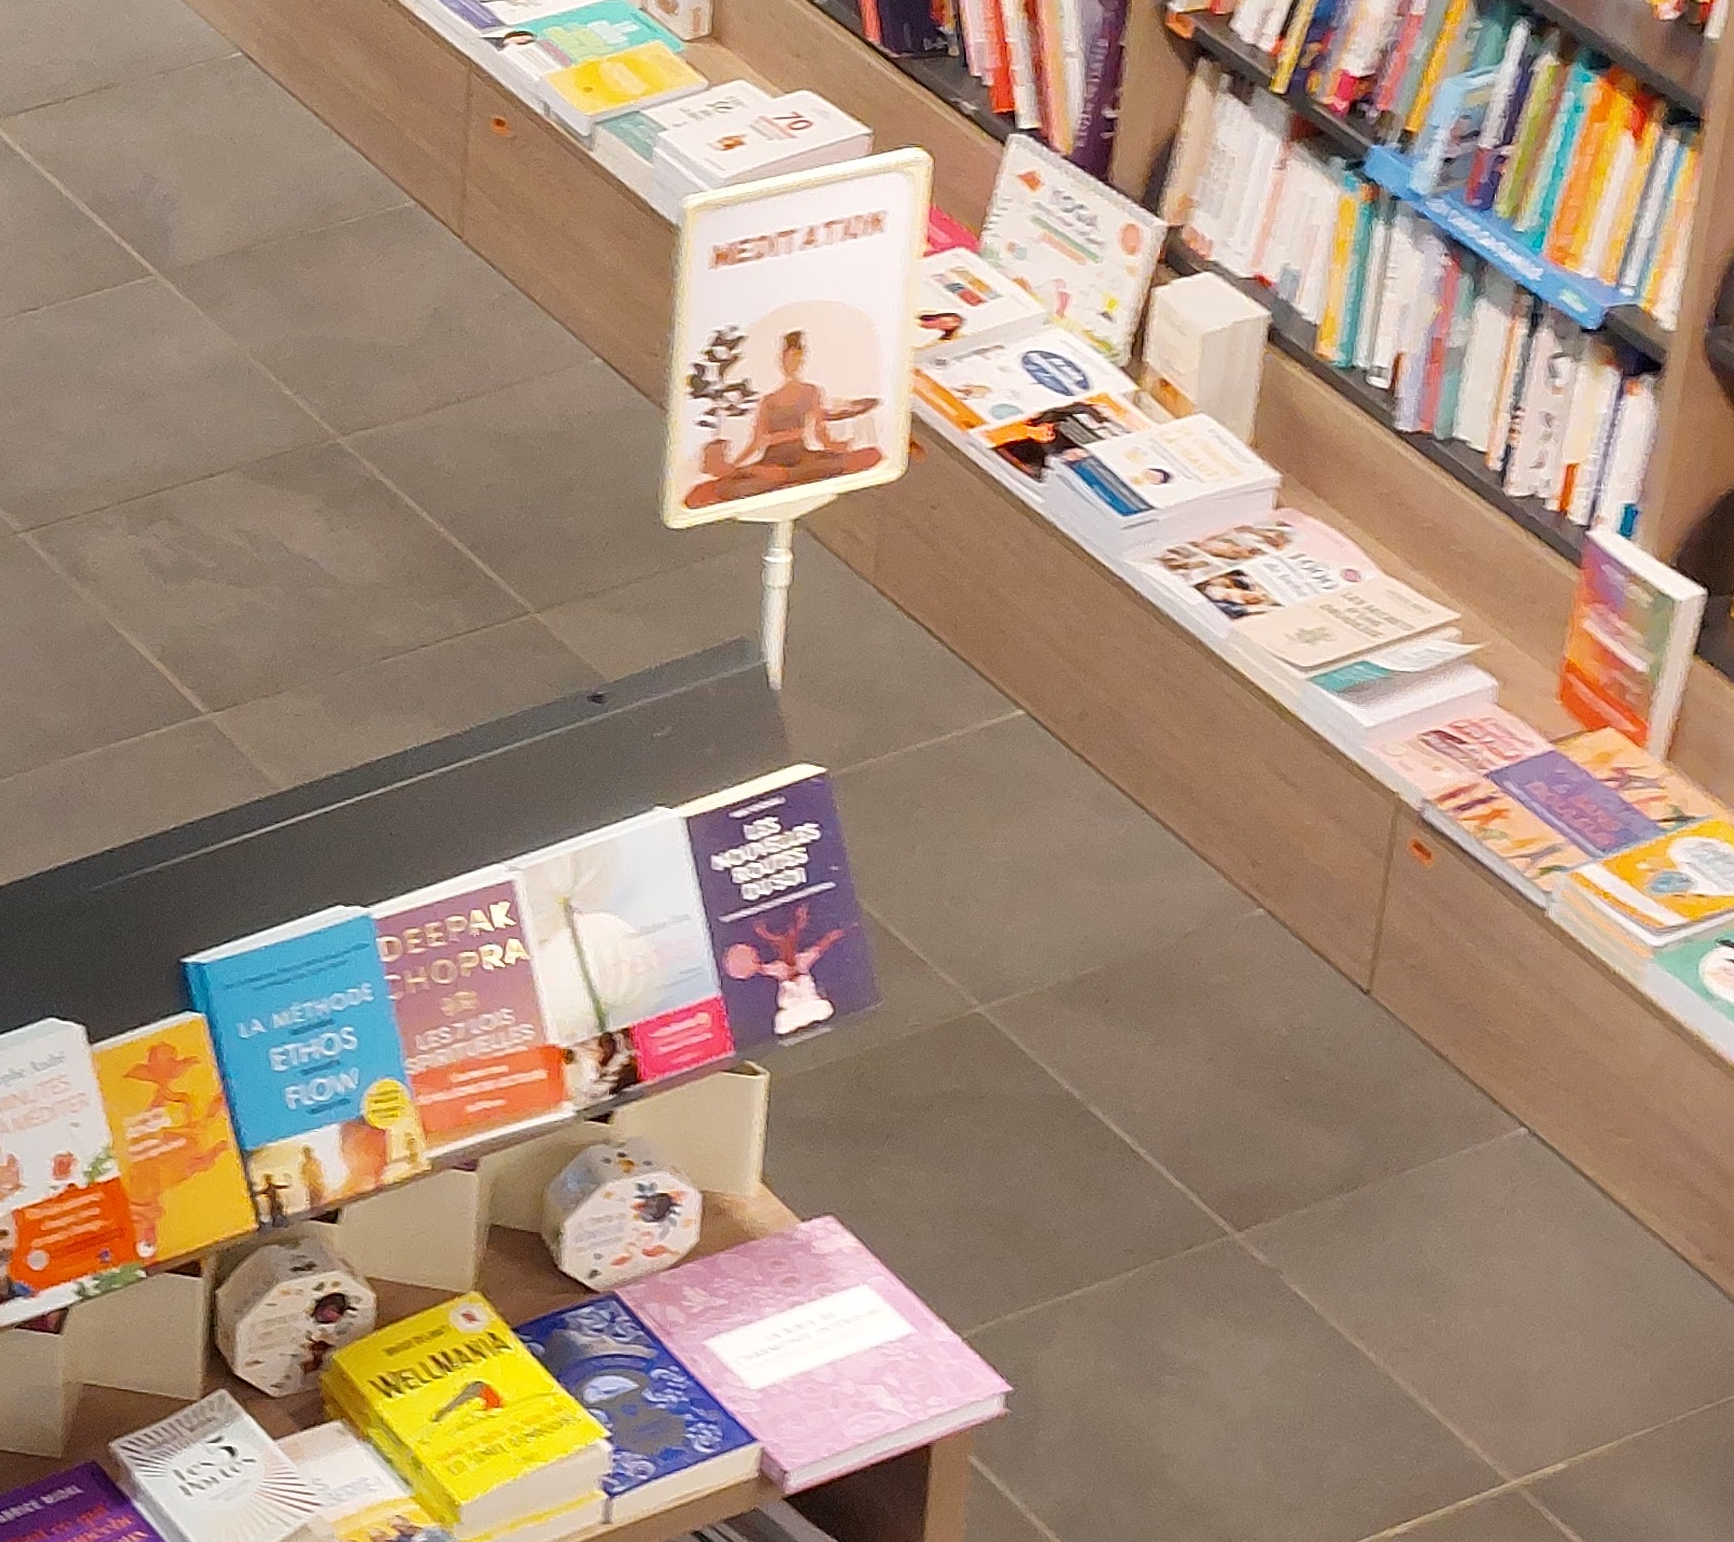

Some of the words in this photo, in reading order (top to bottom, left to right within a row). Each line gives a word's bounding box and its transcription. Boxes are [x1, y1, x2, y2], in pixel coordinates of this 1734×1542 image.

[742, 814, 782, 841] LES
[374, 897, 517, 964] DEEPAK
[235, 1016, 266, 1040] LA
[269, 980, 375, 1029] MÉTHODE
[268, 1024, 361, 1073] ETHOS
[282, 1066, 361, 1111] FLOW
[367, 1330, 513, 1402] WELLMANIA
[205, 1434, 239, 1465] 5
